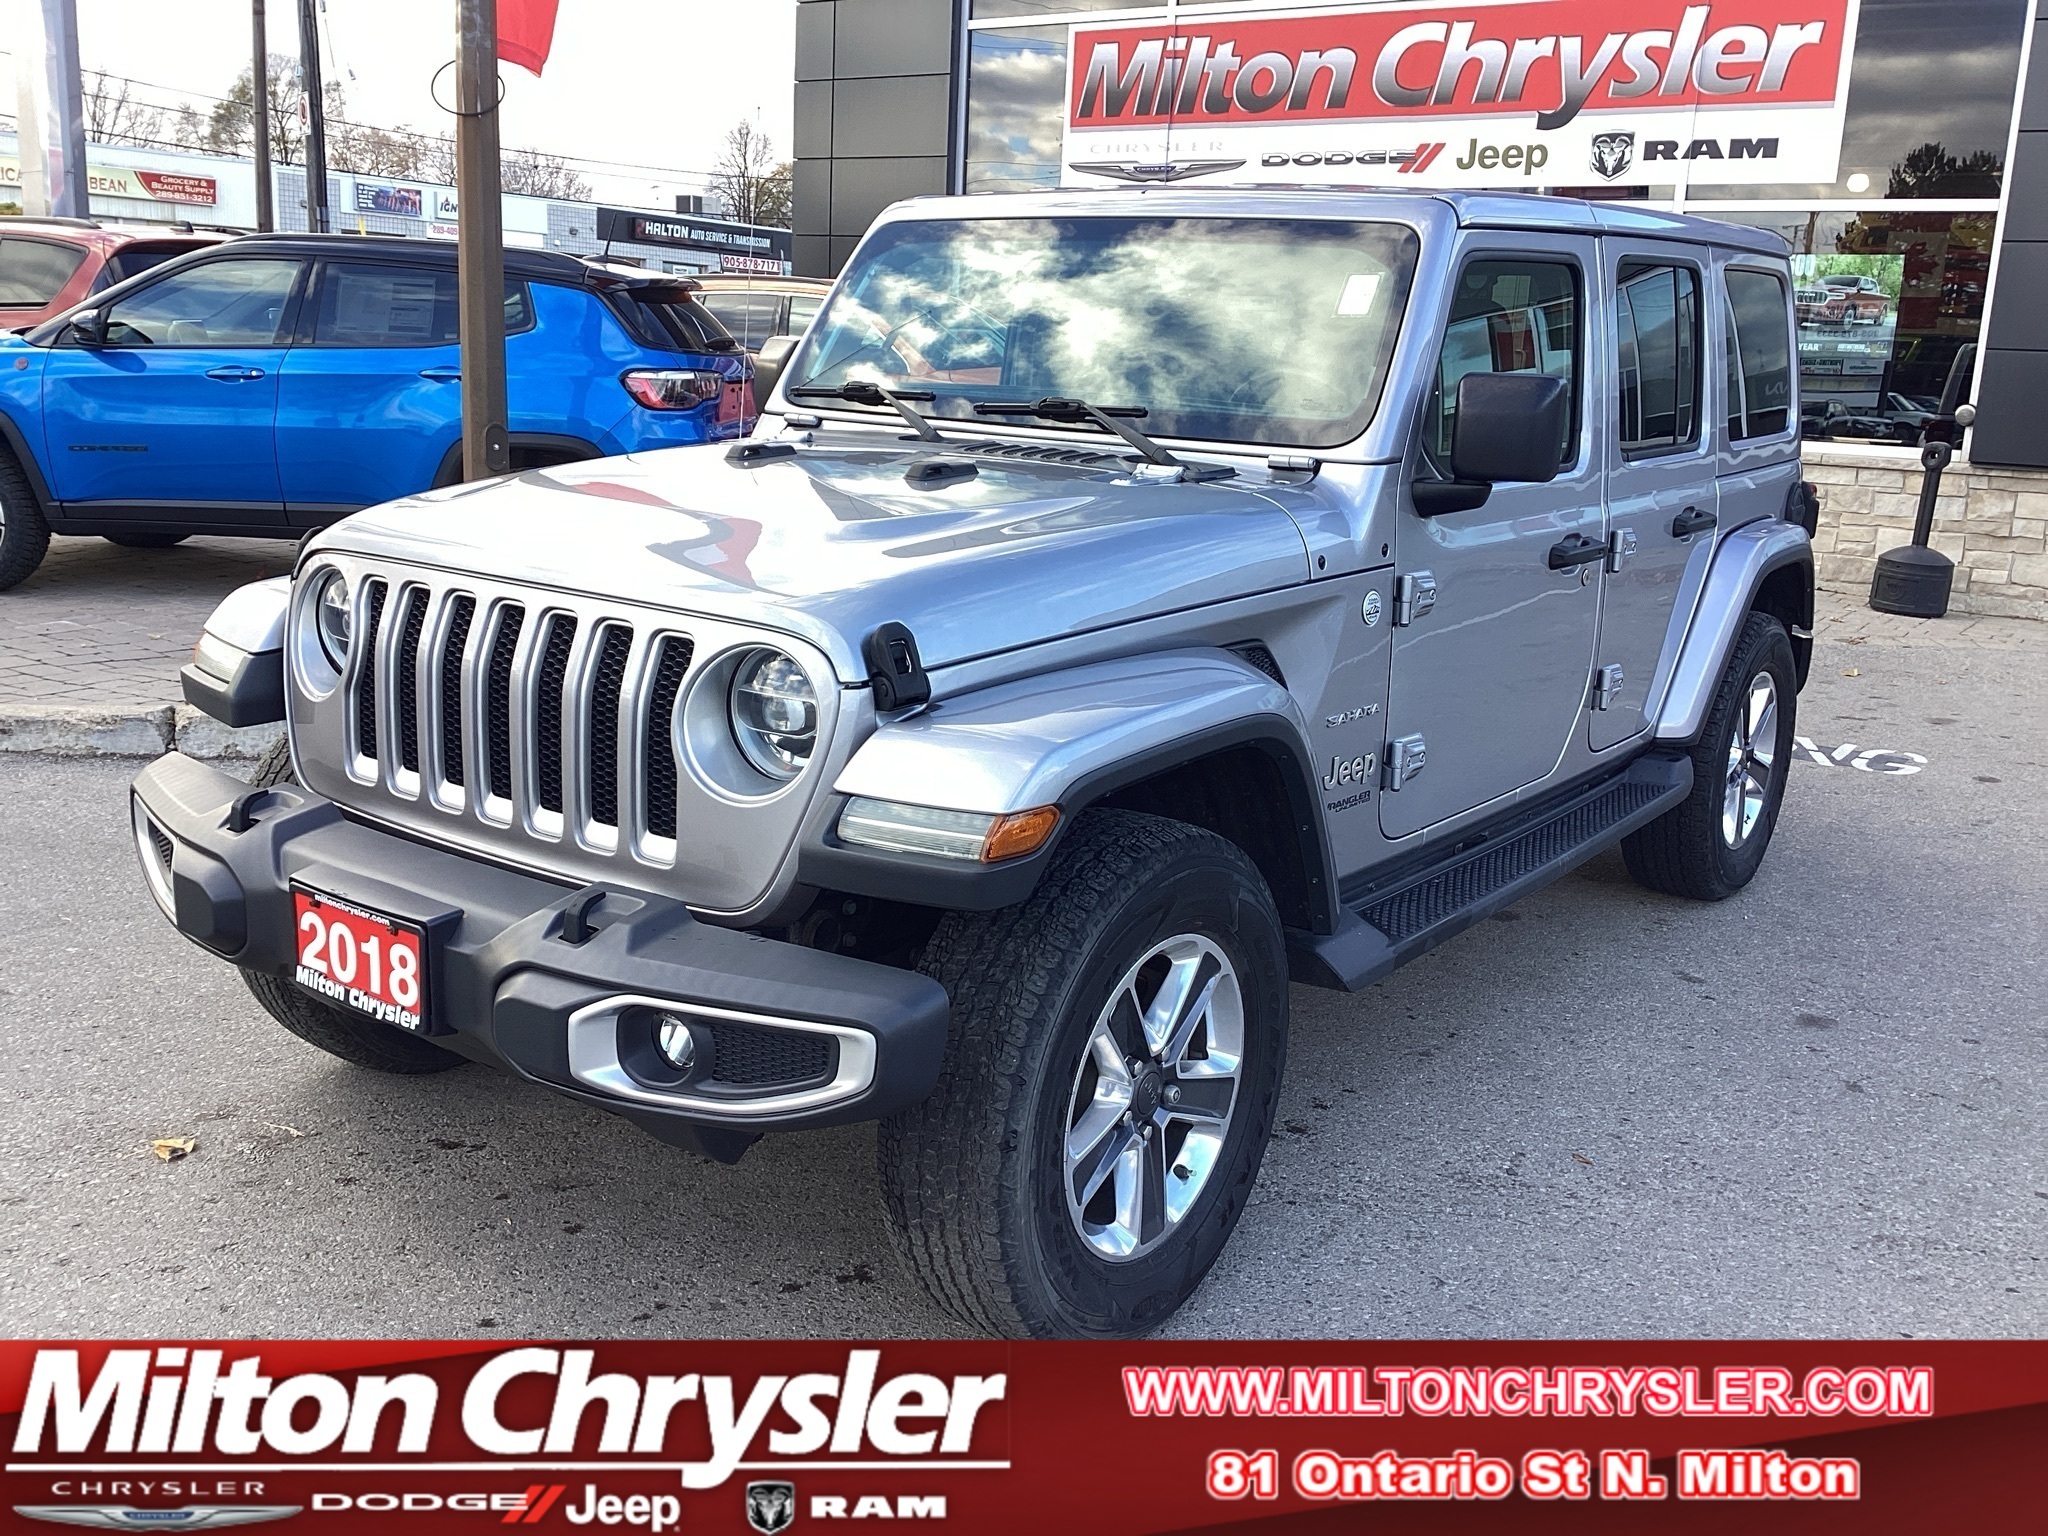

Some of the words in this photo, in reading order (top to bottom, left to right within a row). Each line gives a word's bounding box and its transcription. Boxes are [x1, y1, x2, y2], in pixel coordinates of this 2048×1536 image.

[1075, 36, 1358, 119] Milton
[1372, 5, 1825, 130] Chrysler
[1090, 141, 1223, 154] CHRYSLER
[1261, 150, 1417, 167] DODGE
[1456, 138, 1549, 175] Jeep
[1643, 137, 1780, 161] RAM
[89, 176, 127, 193] BEAN
[200, 179, 207, 187] &
[155, 190, 213, 202] 289-851-3212
[645, 221, 689, 238] HALTON
[690, 230, 705, 240] AUTO
[705, 231, 728, 242] SERVICE
[728, 234, 733, 244] &
[733, 234, 771, 248] TRANSMISSION
[724, 256, 780, 272] 905-878-7171
[1325, 703, 1380, 728] SAHARA
[1323, 752, 1377, 791] Jeep
[314, 893, 390, 926] miltonchrysler.com
[300, 911, 419, 1007] 2018
[296, 964, 345, 1001] Milton
[348, 986, 421, 1030] Chrysler
